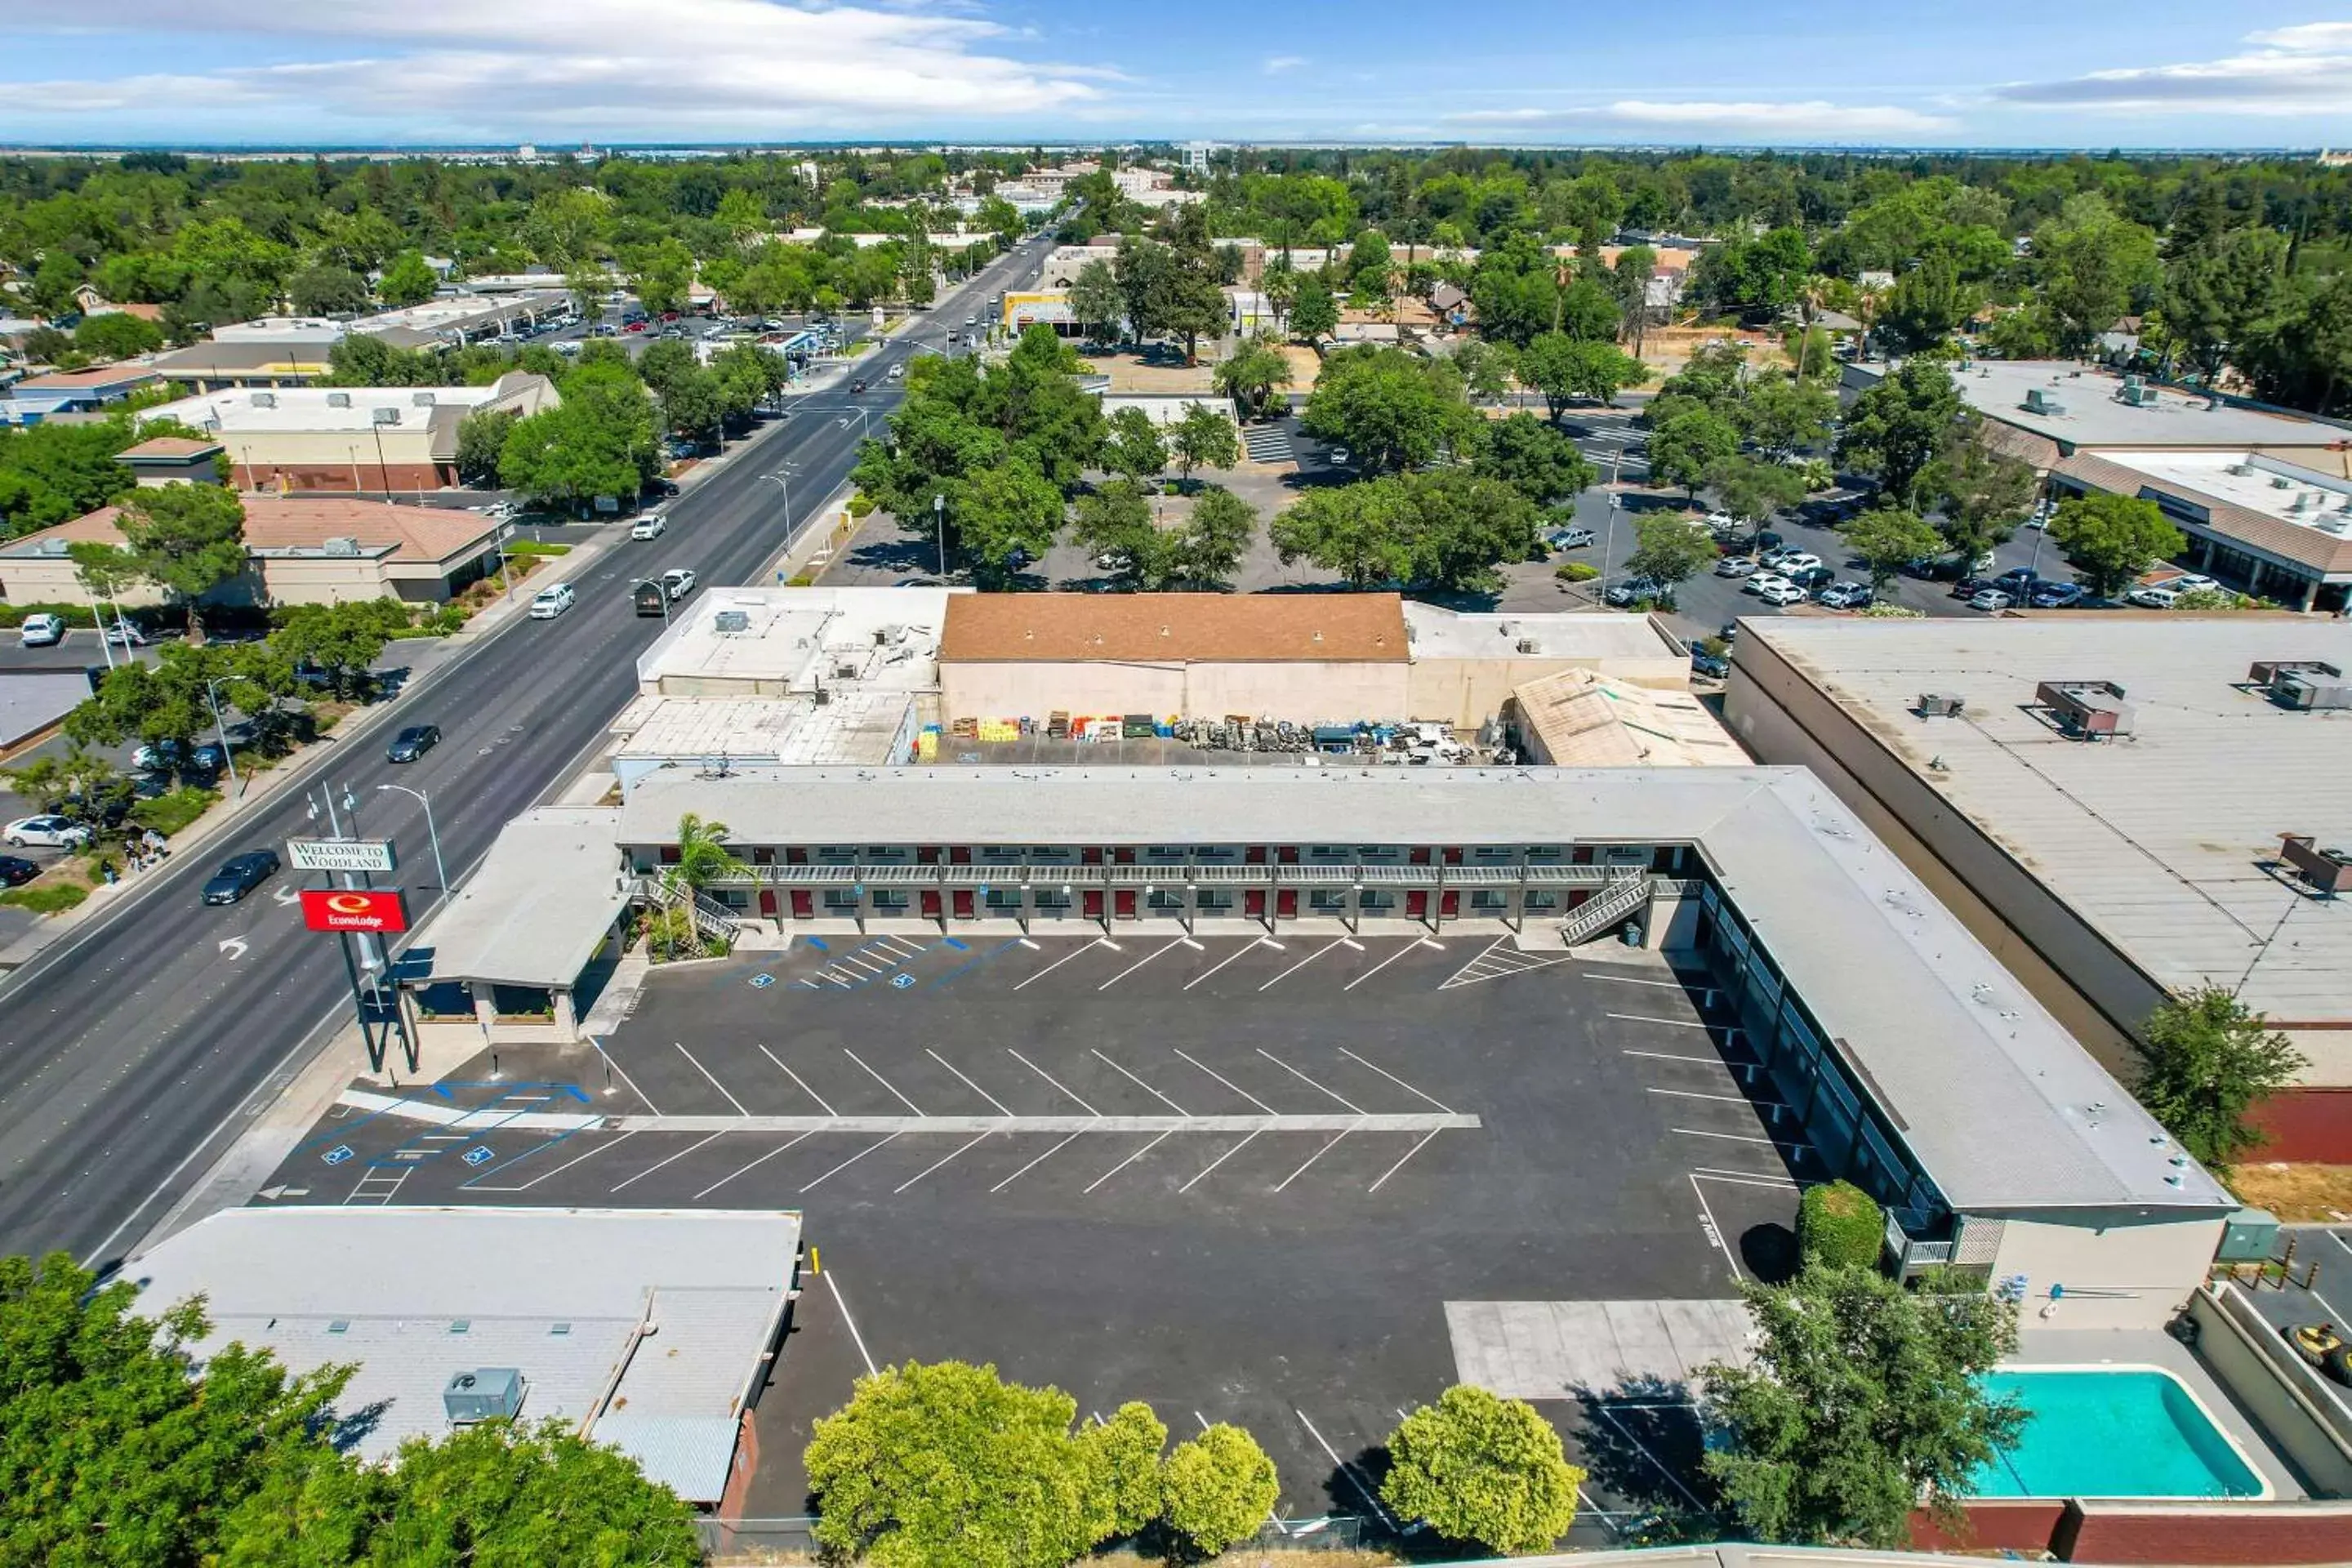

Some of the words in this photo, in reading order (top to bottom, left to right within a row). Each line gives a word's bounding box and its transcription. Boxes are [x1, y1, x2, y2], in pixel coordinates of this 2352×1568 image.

[294, 844, 361, 856] WELCOME
[364, 848, 384, 858] TO
[301, 855, 382, 869] WOODLAND
